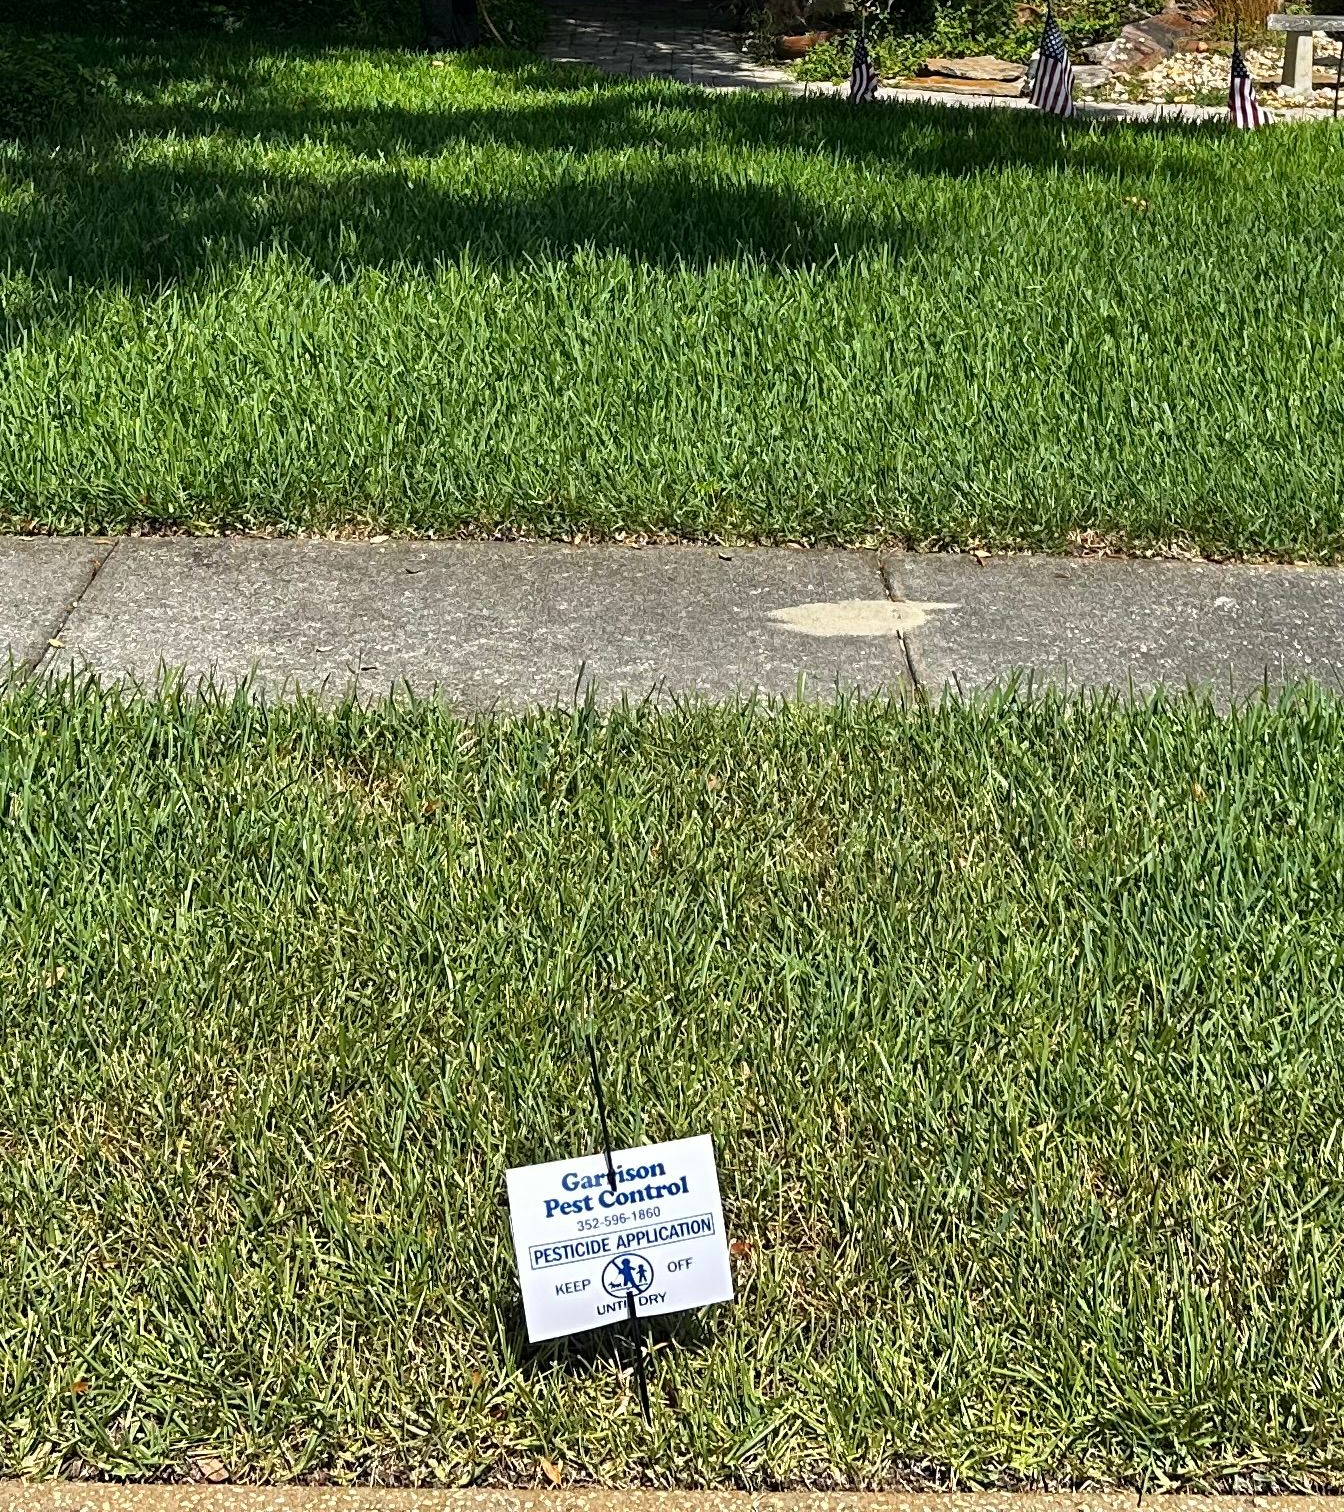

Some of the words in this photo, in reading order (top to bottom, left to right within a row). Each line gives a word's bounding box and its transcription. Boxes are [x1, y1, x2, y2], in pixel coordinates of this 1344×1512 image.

[561, 1163, 666, 1191] Garison
[544, 1195, 594, 1218] Pest
[599, 1177, 689, 1208] Control
[577, 1207, 660, 1231] 352-596-1860
[534, 1238, 611, 1265] PESTICIDE
[617, 1218, 711, 1250] APPLICATION
[555, 1279, 591, 1295] KEEP
[668, 1258, 693, 1272] OFF
[597, 1299, 635, 1315] UNTI
[639, 1292, 666, 1306] DRY
